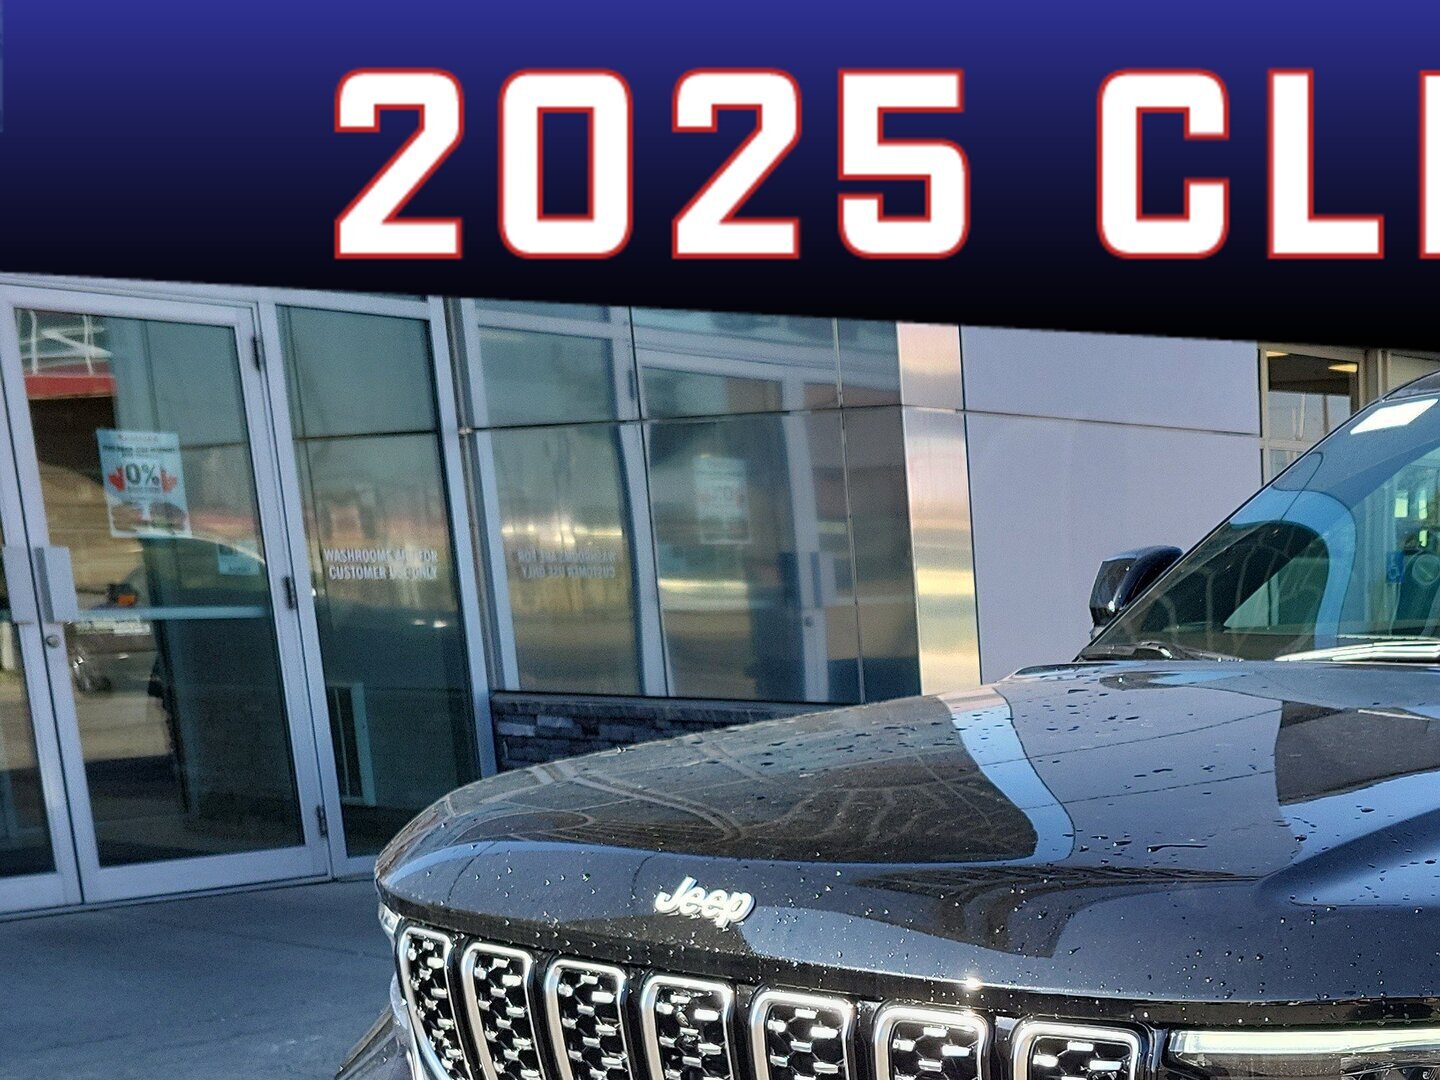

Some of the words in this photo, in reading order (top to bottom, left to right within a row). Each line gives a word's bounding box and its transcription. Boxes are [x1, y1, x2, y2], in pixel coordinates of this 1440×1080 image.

[125, 463, 160, 486] 0%
[329, 566, 386, 580] CUSTOMER
[655, 876, 755, 930] Jeep
